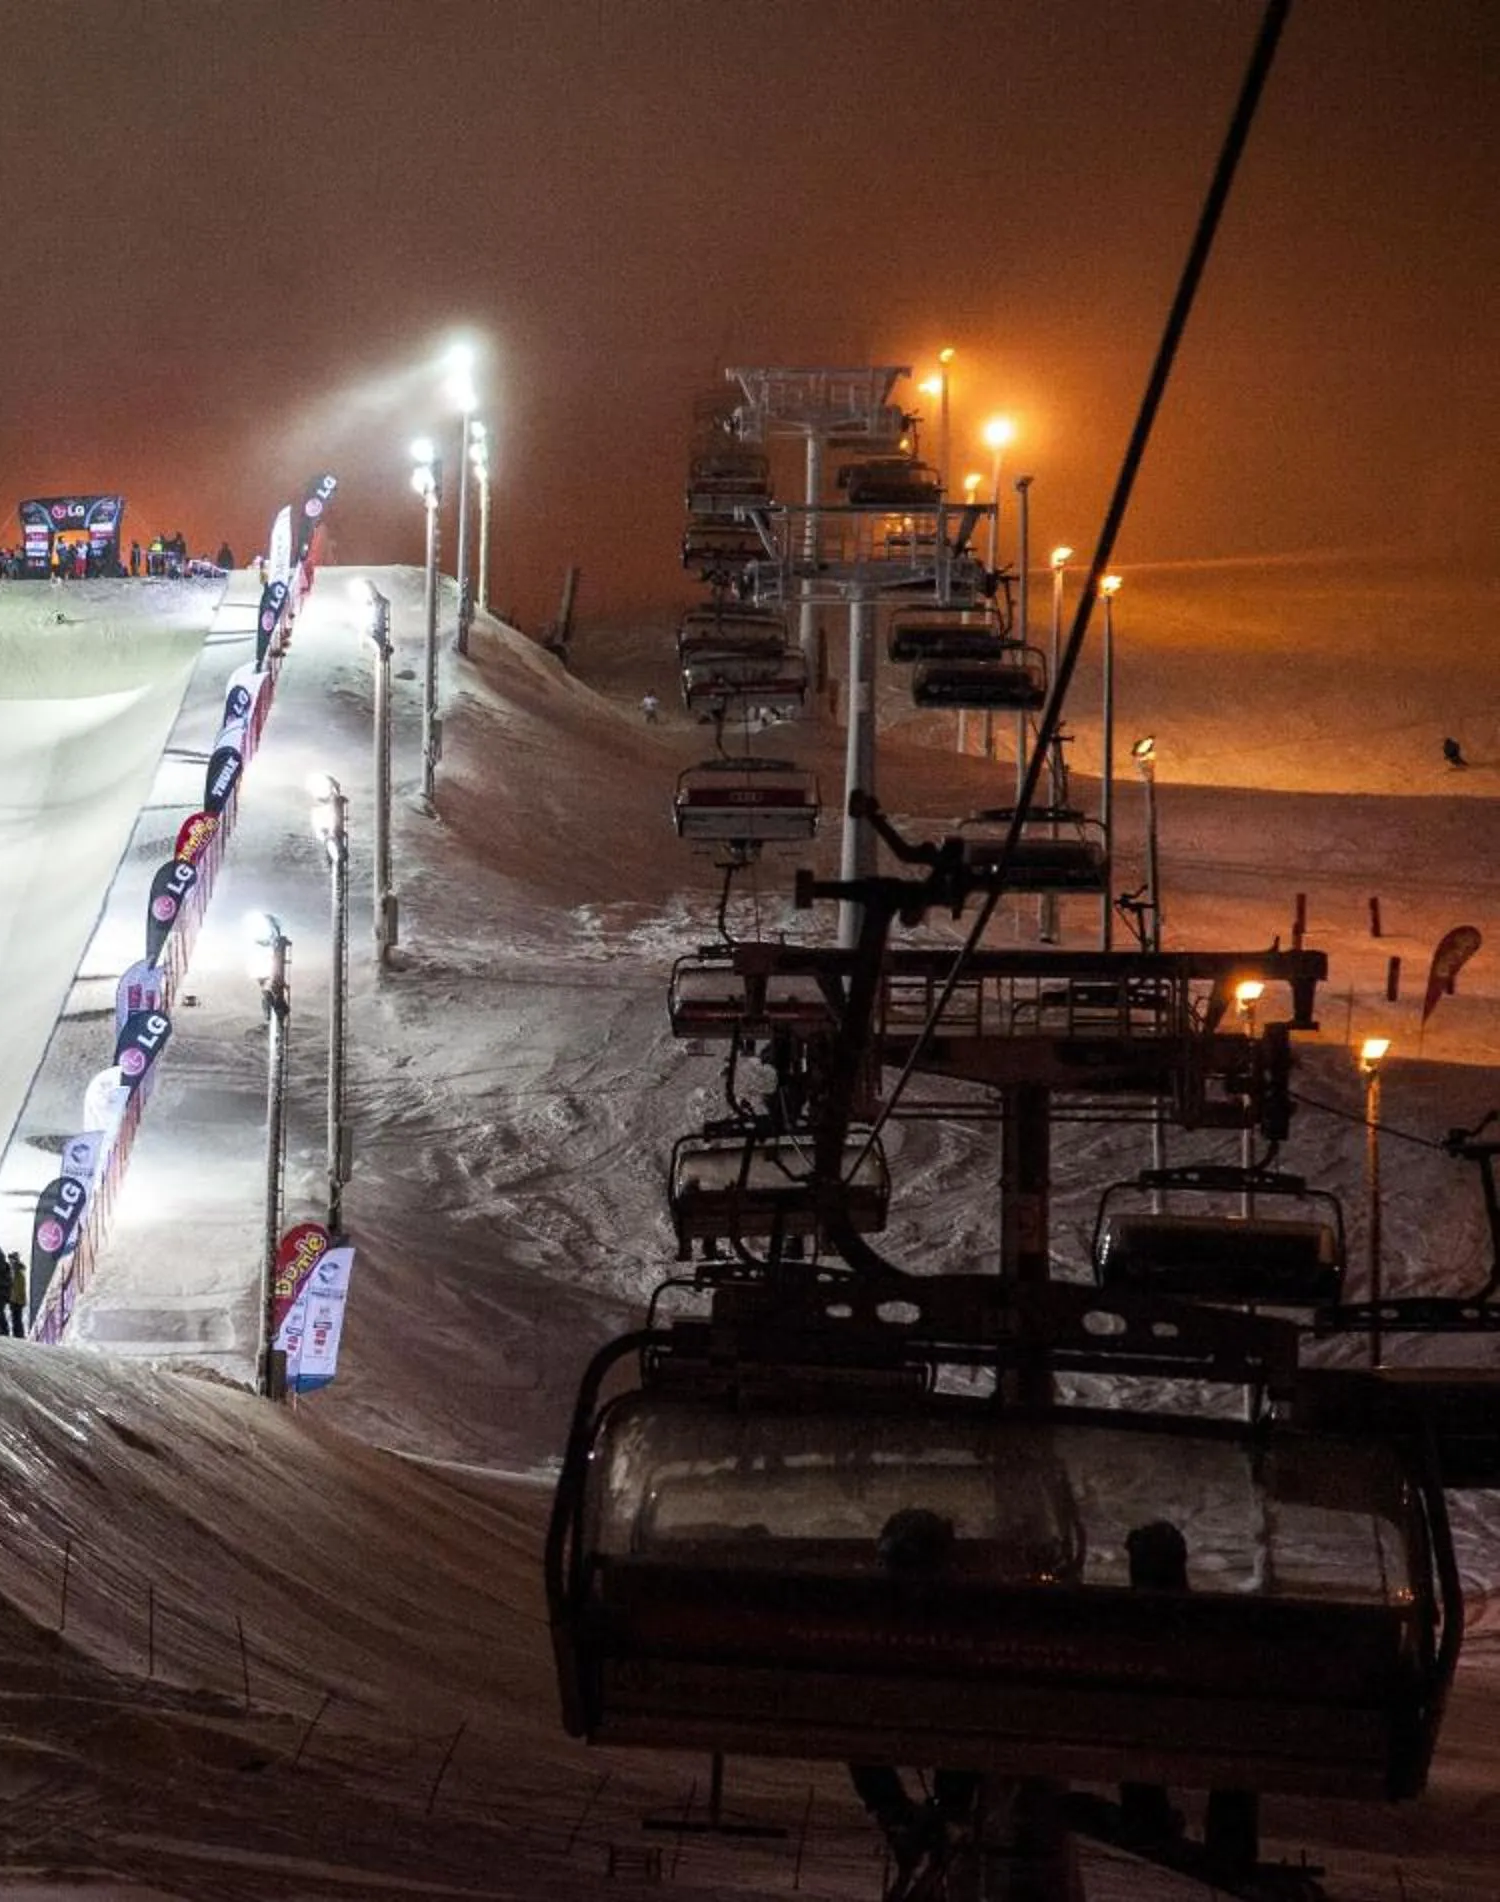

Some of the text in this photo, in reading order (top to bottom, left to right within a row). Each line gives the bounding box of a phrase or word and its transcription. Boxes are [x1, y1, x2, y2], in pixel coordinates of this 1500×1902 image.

[317, 475, 337, 498] LG
[67, 505, 85, 517] LG
[270, 585, 285, 609] LG
[233, 690, 248, 714] LG
[166, 864, 195, 894] LG
[137, 1015, 168, 1047] LG
[53, 1181, 82, 1220] LG
